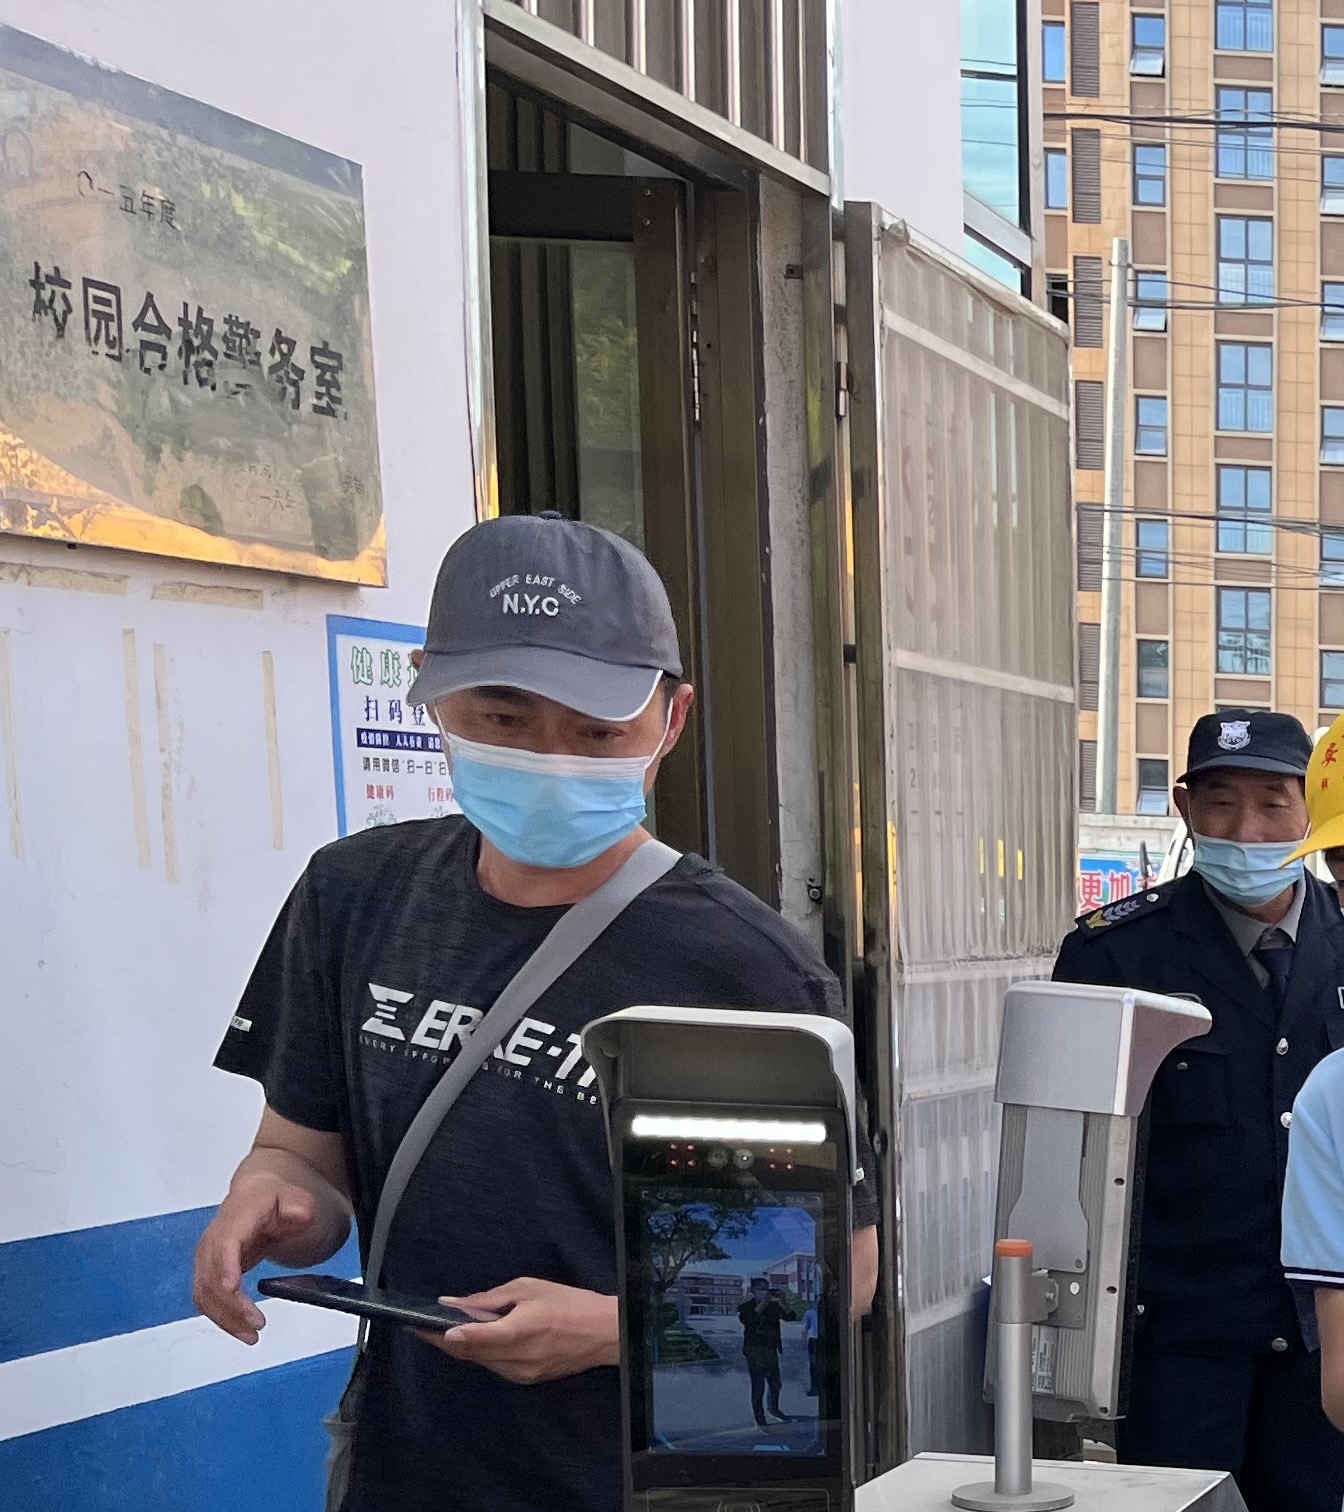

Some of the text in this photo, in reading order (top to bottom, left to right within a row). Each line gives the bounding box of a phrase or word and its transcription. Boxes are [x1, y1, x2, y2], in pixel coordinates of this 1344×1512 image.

[28, 260, 347, 420] 校园合格警务室
[489, 573, 582, 605] UPPER EAST SIDE
[502, 593, 559, 617] N.Y.C
[1080, 870, 1157, 912] 更加
